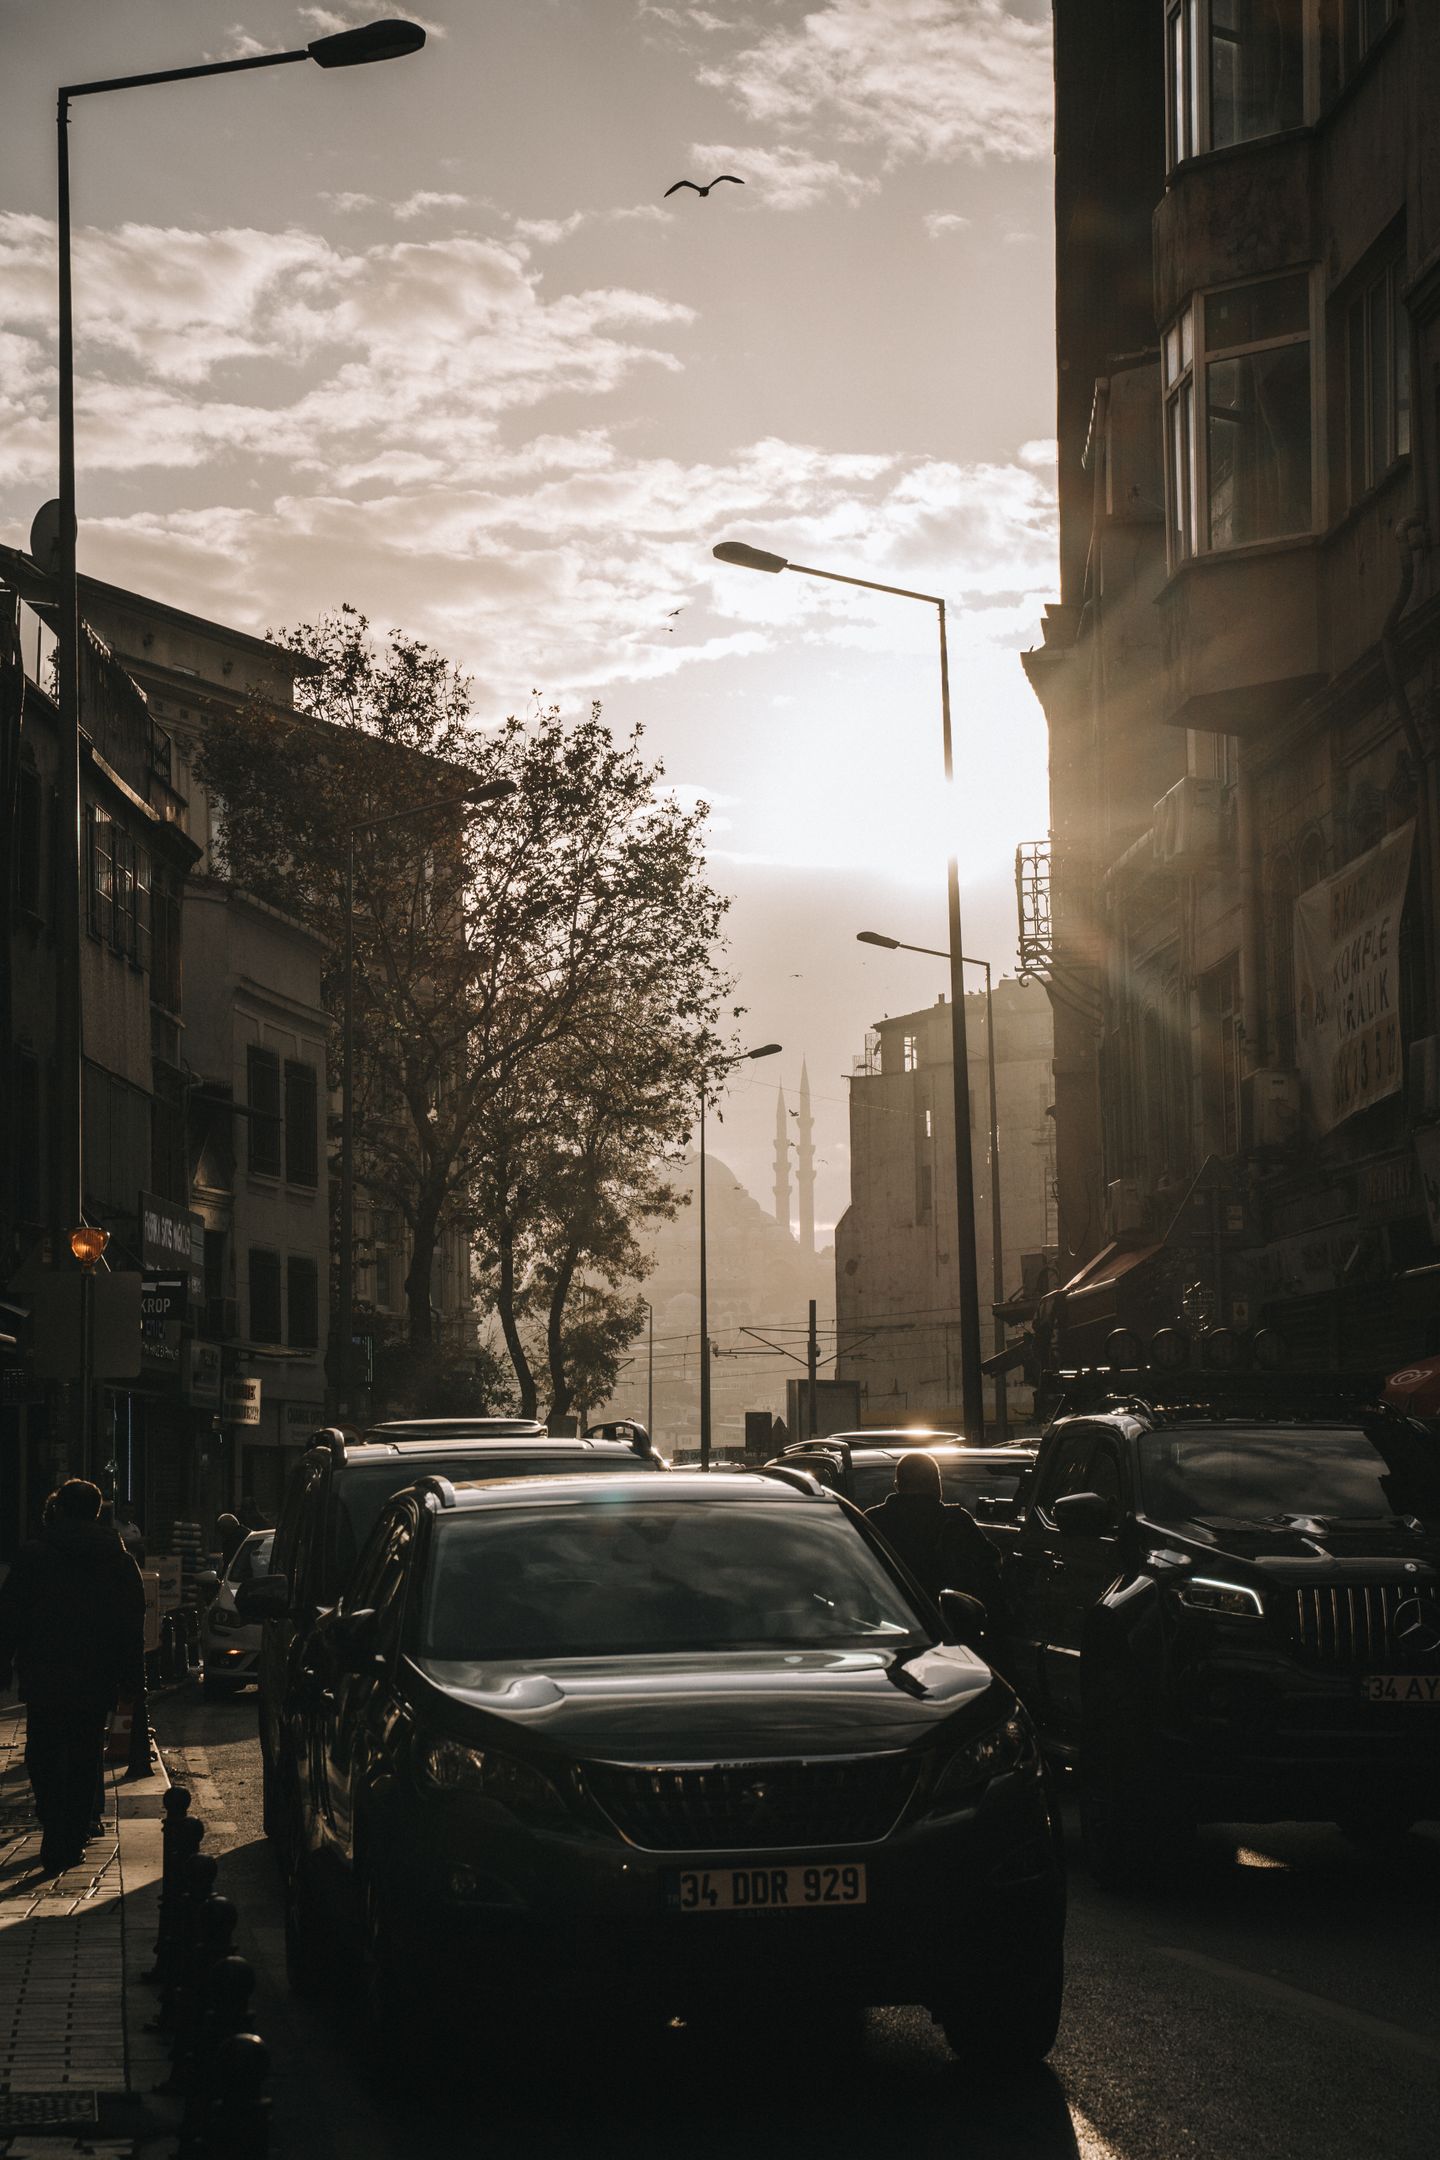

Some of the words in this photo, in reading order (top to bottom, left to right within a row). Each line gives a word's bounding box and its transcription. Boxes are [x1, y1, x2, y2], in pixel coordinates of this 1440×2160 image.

[1332, 916, 1391, 991] KOMPLE
[1372, 1677, 1398, 1699] 34
[681, 1873, 718, 1907] 34
[732, 1870, 788, 1905] DDR
[804, 1867, 859, 1902] 929
